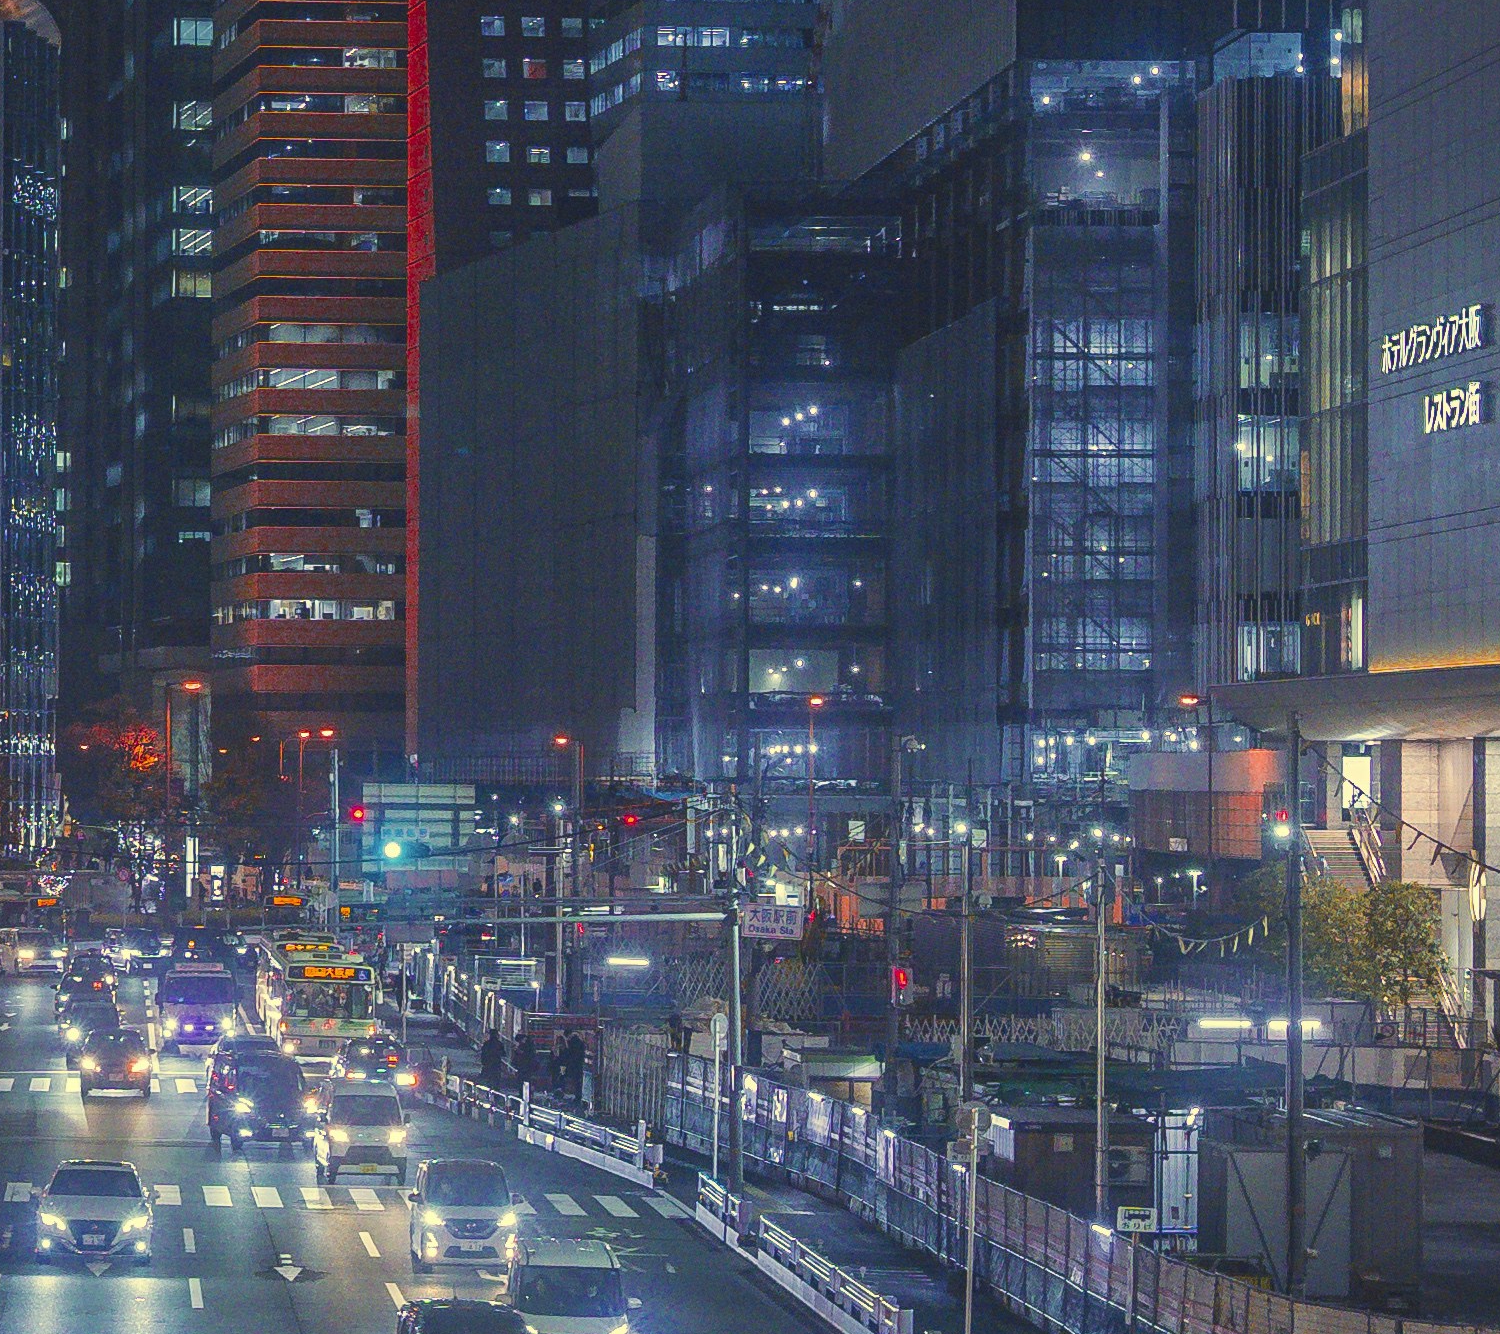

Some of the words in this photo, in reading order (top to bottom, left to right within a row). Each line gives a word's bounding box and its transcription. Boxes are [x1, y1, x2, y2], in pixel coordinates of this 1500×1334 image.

[1381, 303, 1483, 375] ホテルグランヴィア大阪
[749, 924, 776, 934] Osaka
